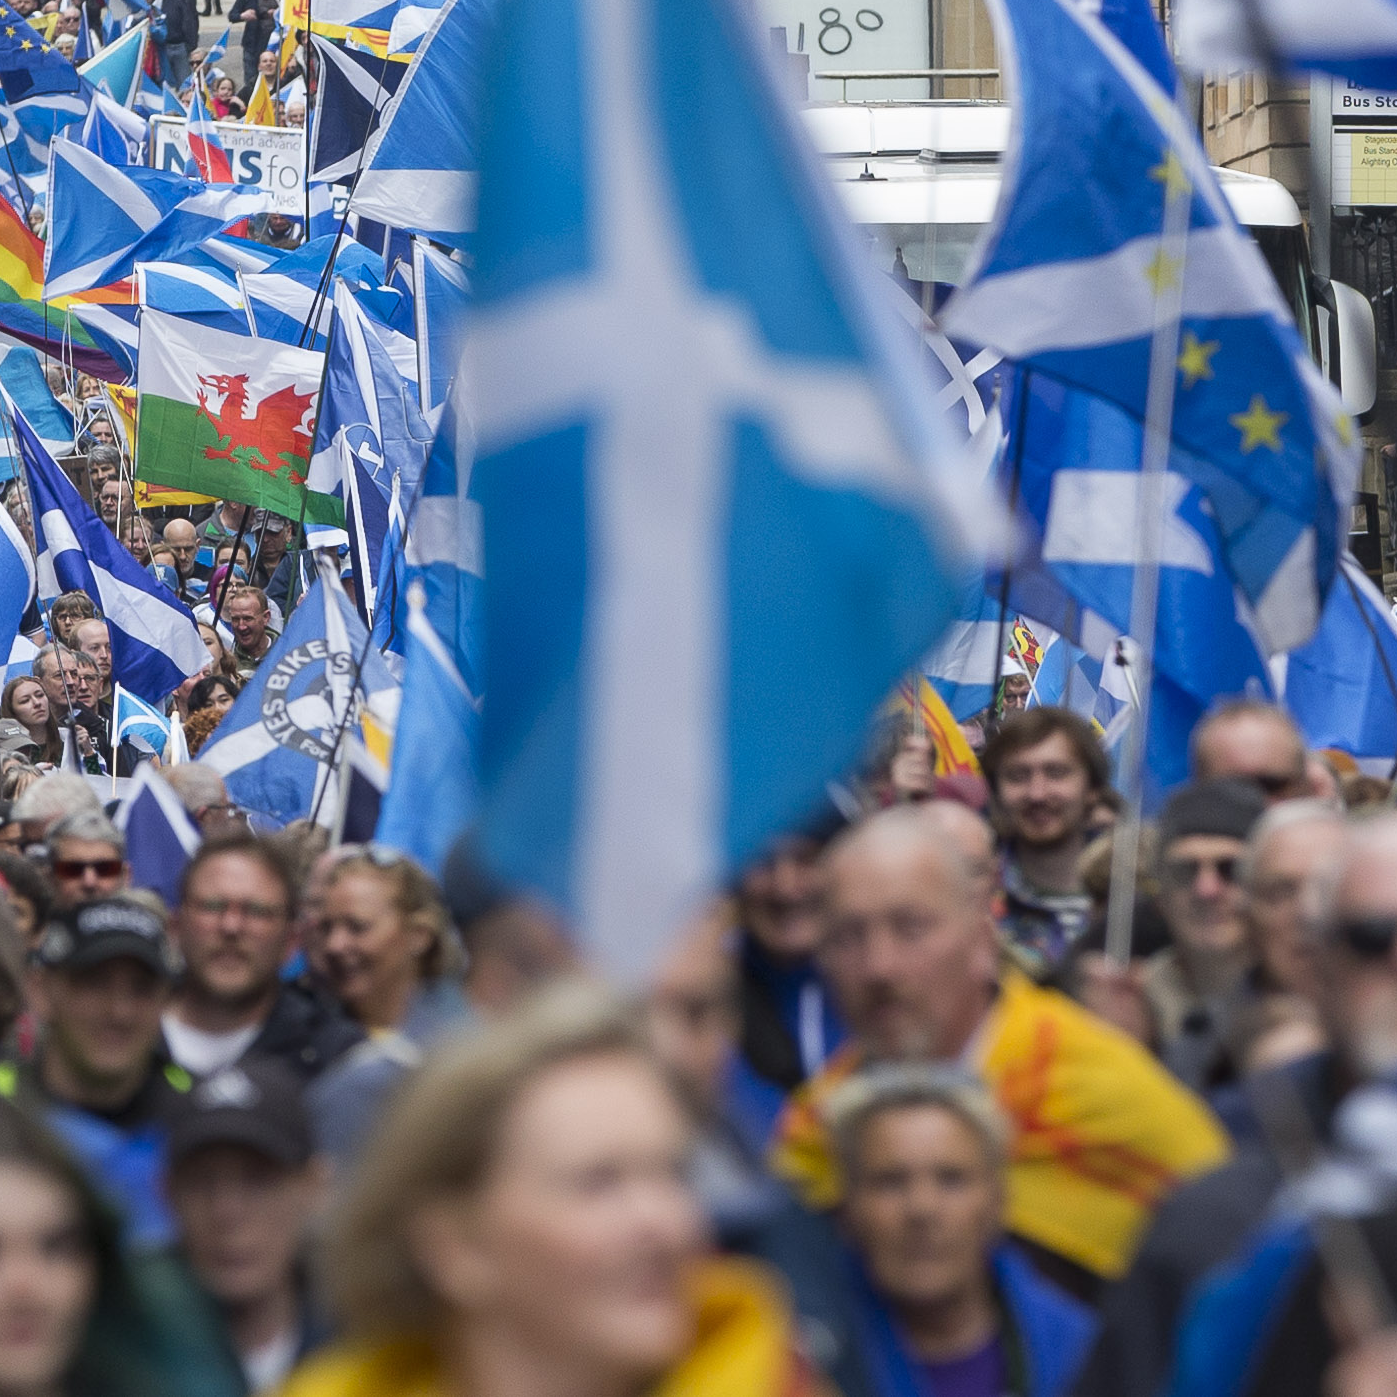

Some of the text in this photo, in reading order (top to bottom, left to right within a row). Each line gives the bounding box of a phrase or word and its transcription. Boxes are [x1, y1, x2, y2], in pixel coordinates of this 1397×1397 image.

[1343, 95, 1370, 108] Bus
[231, 136, 254, 147] and
[1364, 147, 1377, 155] Bus
[1361, 158, 1391, 167] Alighting
[262, 697, 297, 745] YES
